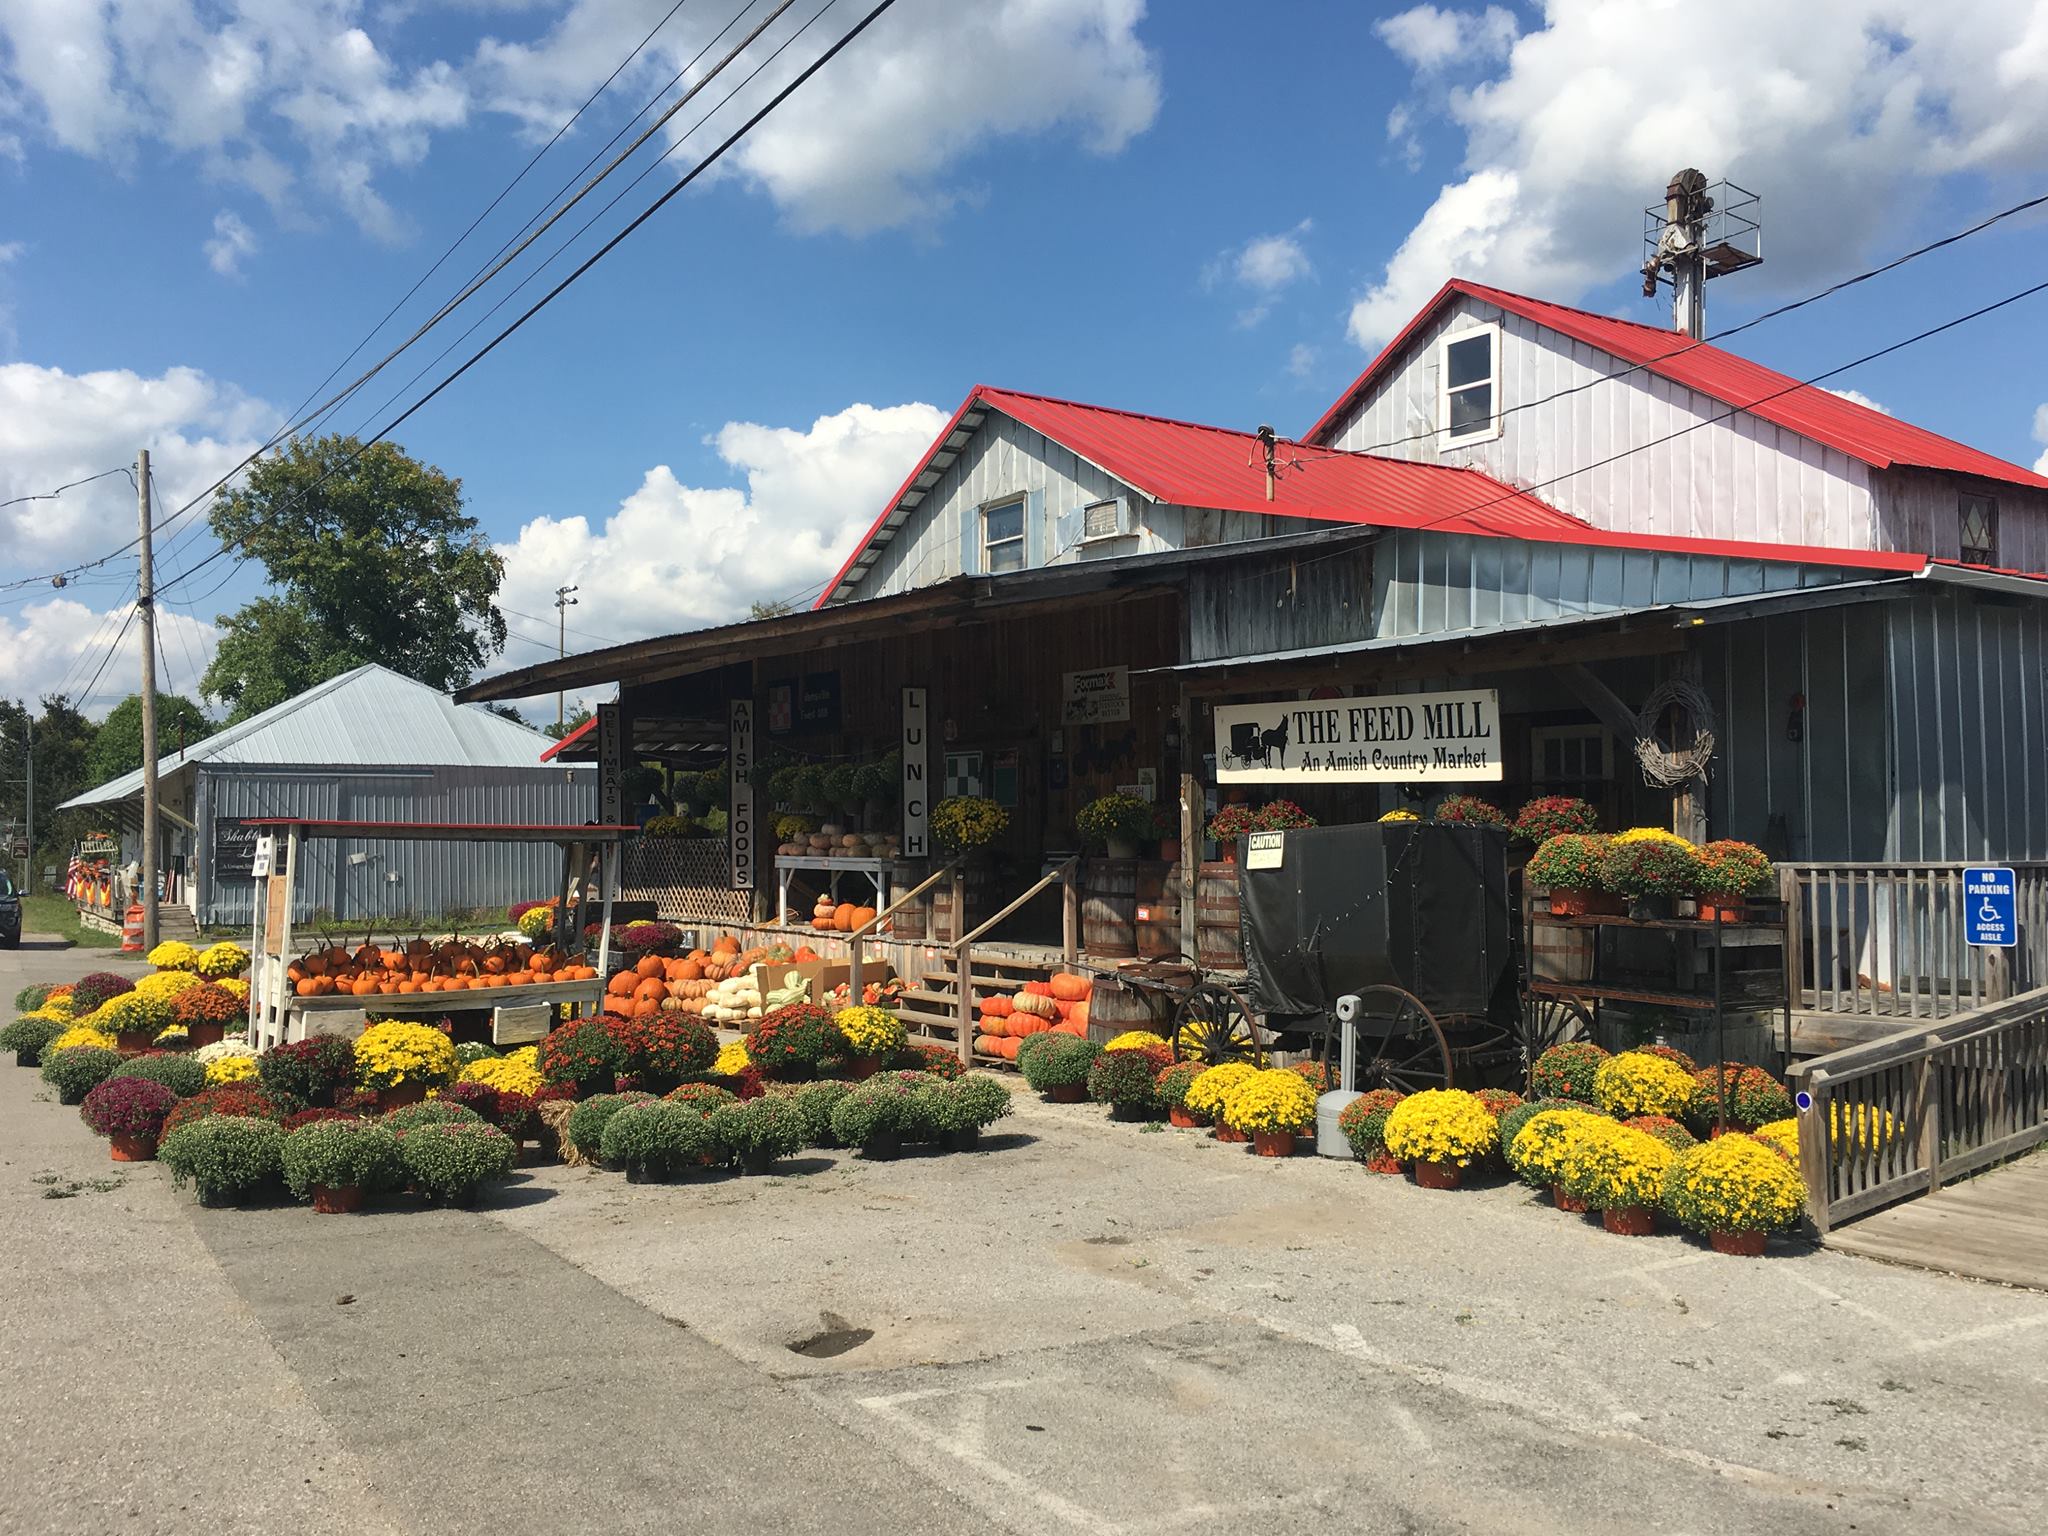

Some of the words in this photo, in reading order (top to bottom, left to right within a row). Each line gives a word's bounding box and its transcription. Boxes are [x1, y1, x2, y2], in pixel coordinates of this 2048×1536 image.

[1292, 709, 1341, 745] THE
[1346, 704, 1414, 744] FEED
[1422, 700, 1491, 740] MILL
[733, 703, 750, 784] AMISH
[1300, 751, 1321, 772] An
[1324, 748, 1368, 772] Amish
[1372, 747, 1428, 775] Country
[1432, 746, 1488, 770] Market
[906, 691, 922, 853] LUNCH
[221, 828, 259, 843] Shabb
[1251, 834, 1281, 849] CAUTION
[735, 803, 749, 885] FOODS
[1981, 872, 1996, 882] NO
[1968, 884, 2010, 895] PARKING
[1976, 923, 2005, 932] ACCESS
[1980, 932, 2002, 942] AISLE
